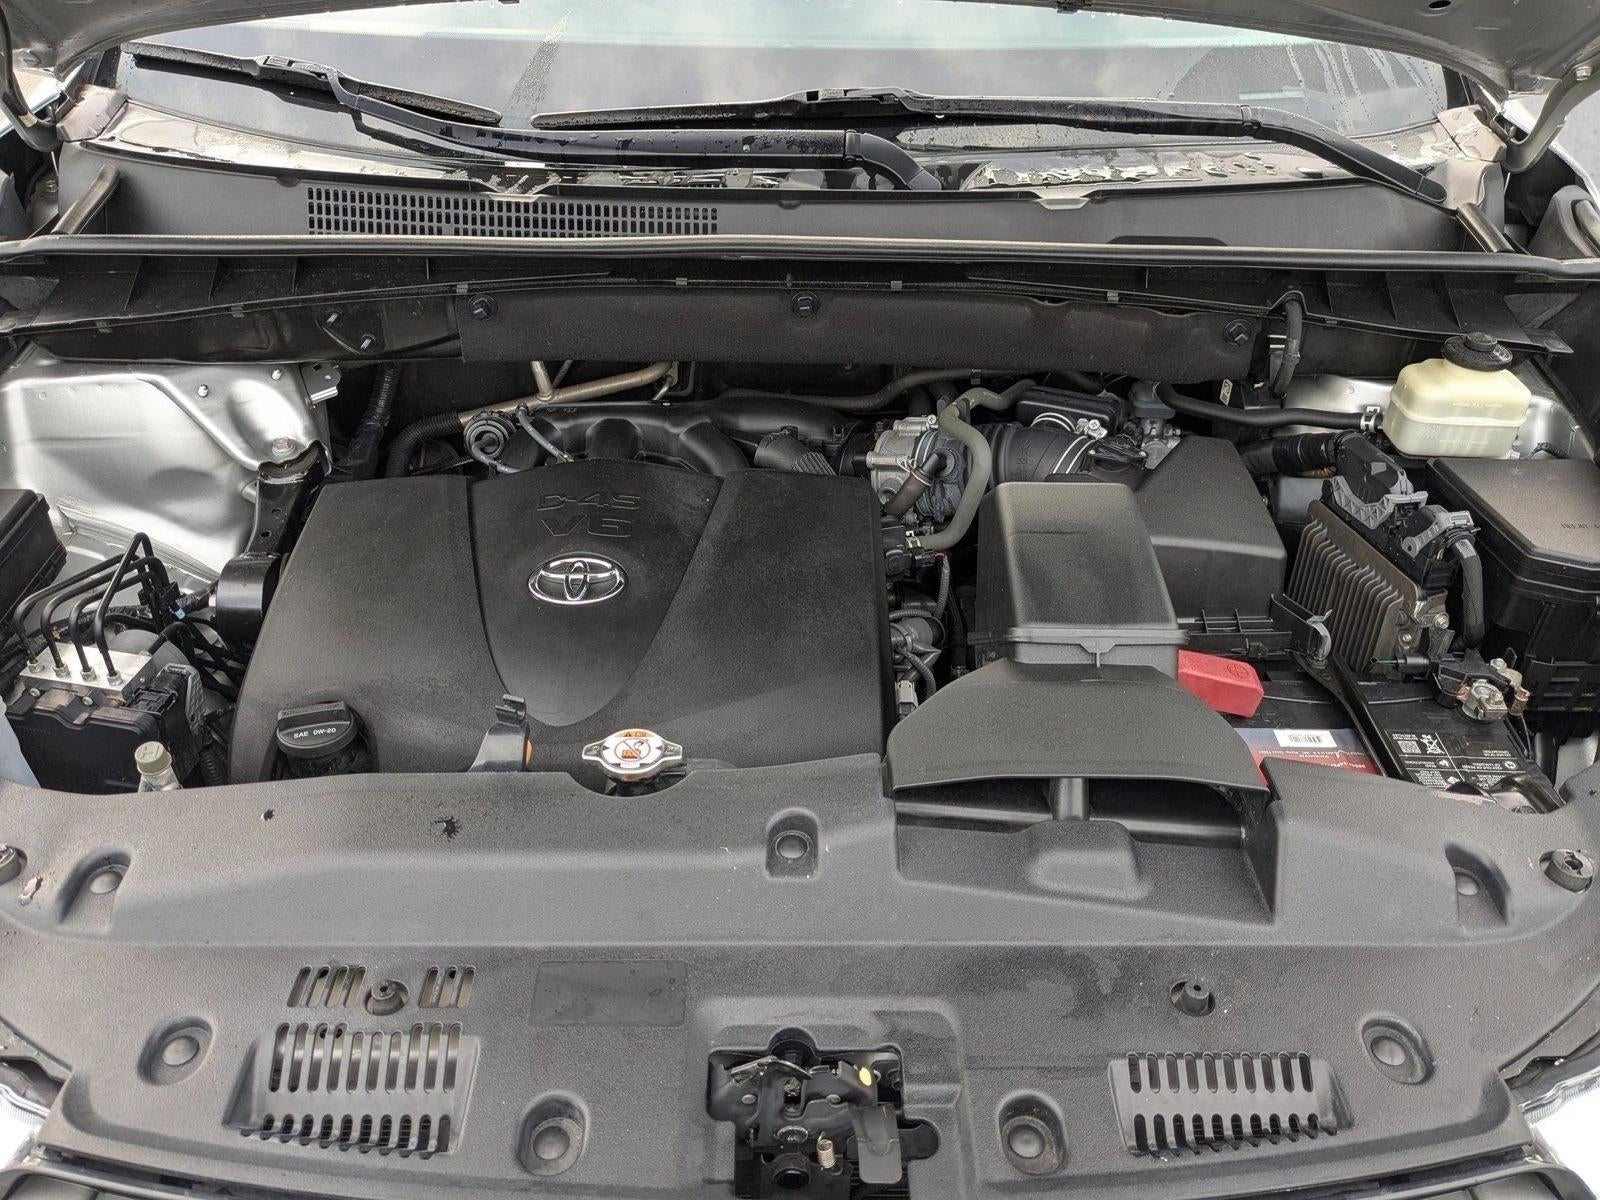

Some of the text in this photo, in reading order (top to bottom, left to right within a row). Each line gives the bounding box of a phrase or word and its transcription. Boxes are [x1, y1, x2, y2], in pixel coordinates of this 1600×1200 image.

[537, 513, 633, 538] V6
[293, 727, 336, 739] SAE 0W-20
